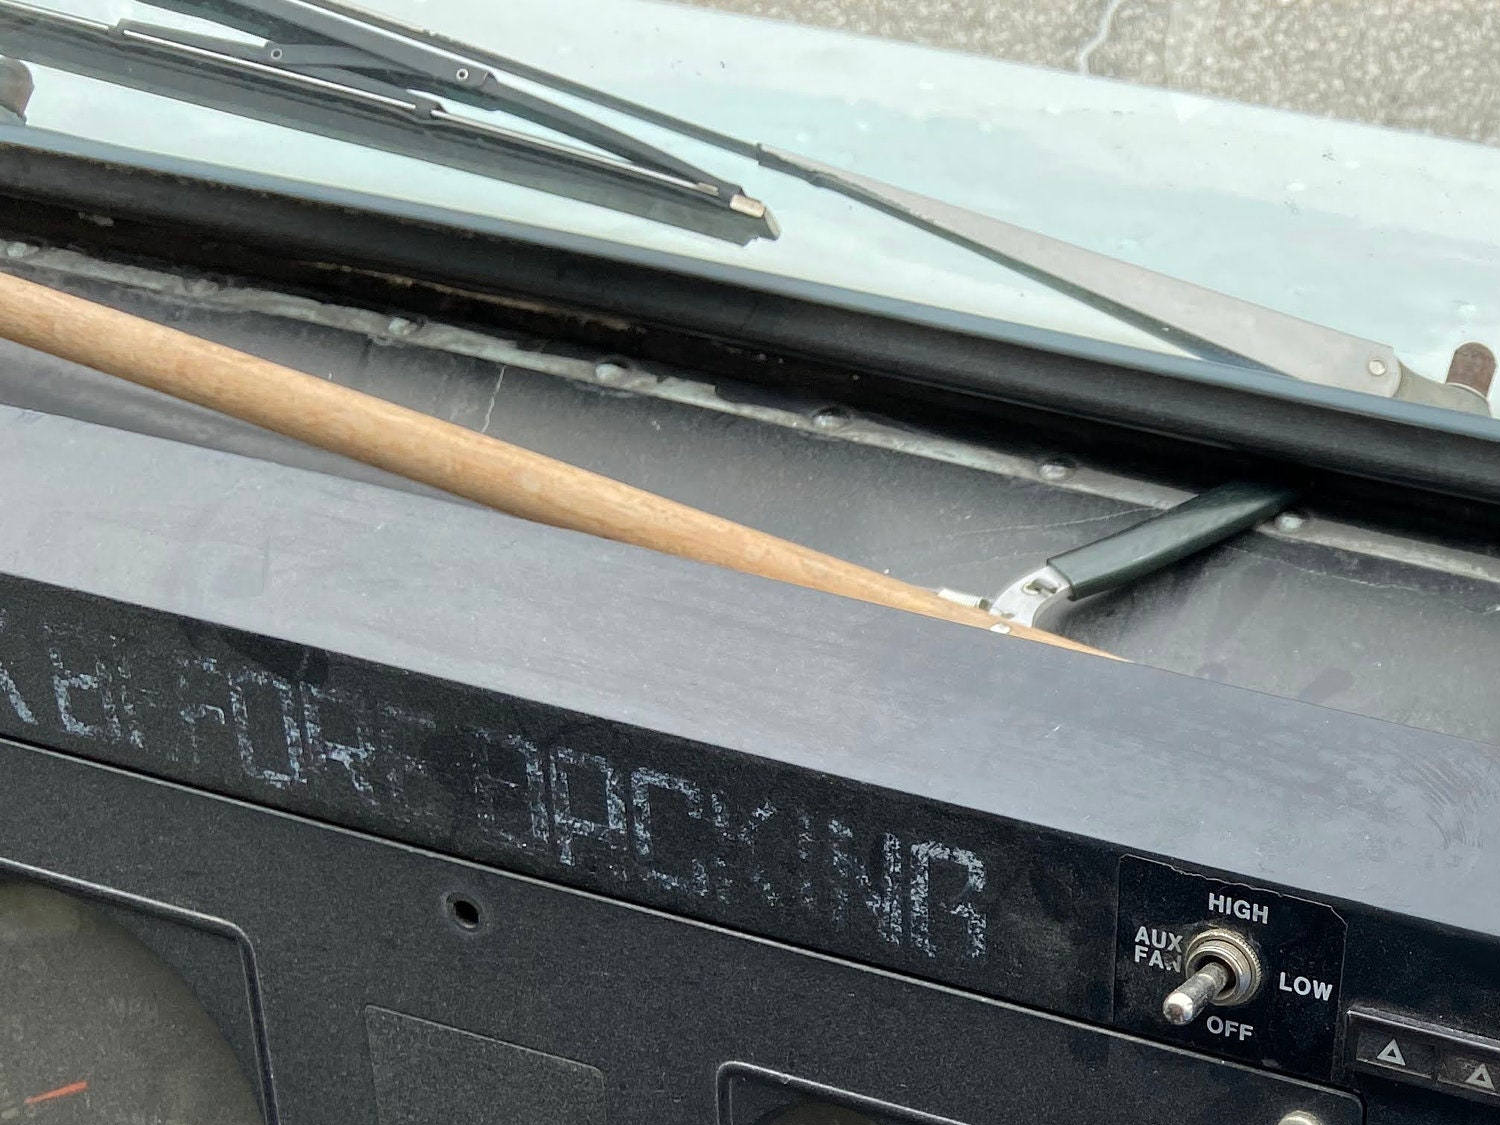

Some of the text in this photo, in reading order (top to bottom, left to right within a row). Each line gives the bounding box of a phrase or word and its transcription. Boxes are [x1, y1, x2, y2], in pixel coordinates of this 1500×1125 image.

[1208, 892, 1269, 924] HIGH
[1134, 925, 1183, 953] AUX
[1134, 945, 1182, 973] FAN
[1279, 971, 1333, 1001] LOW
[1206, 1015, 1254, 1041] OFF
